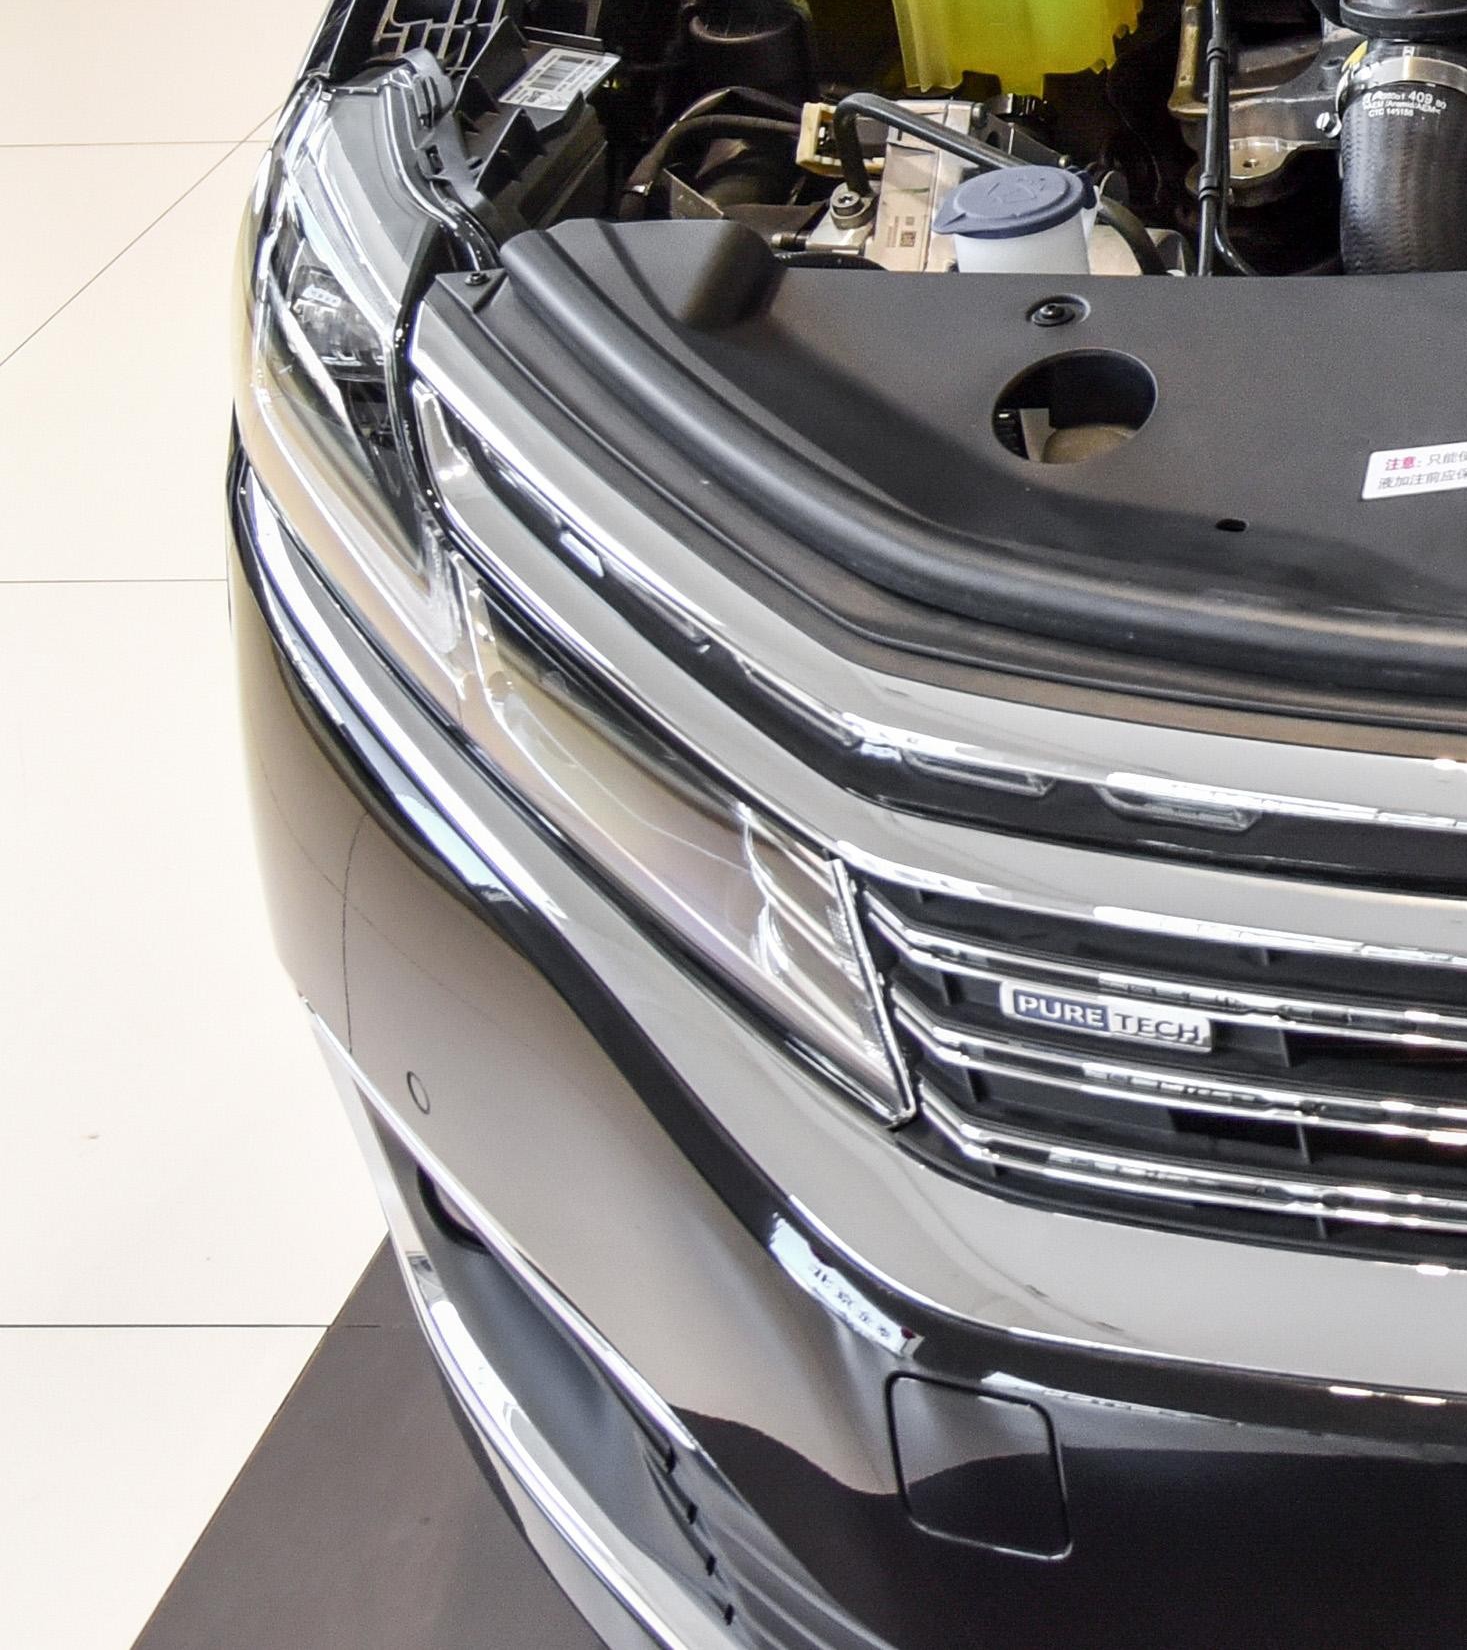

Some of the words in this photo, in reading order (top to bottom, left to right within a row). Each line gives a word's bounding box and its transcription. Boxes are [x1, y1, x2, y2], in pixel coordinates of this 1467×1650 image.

[1408, 90, 1434, 105] 409
[1016, 994, 1104, 1027] PURE
[1114, 1012, 1201, 1044] TECH
